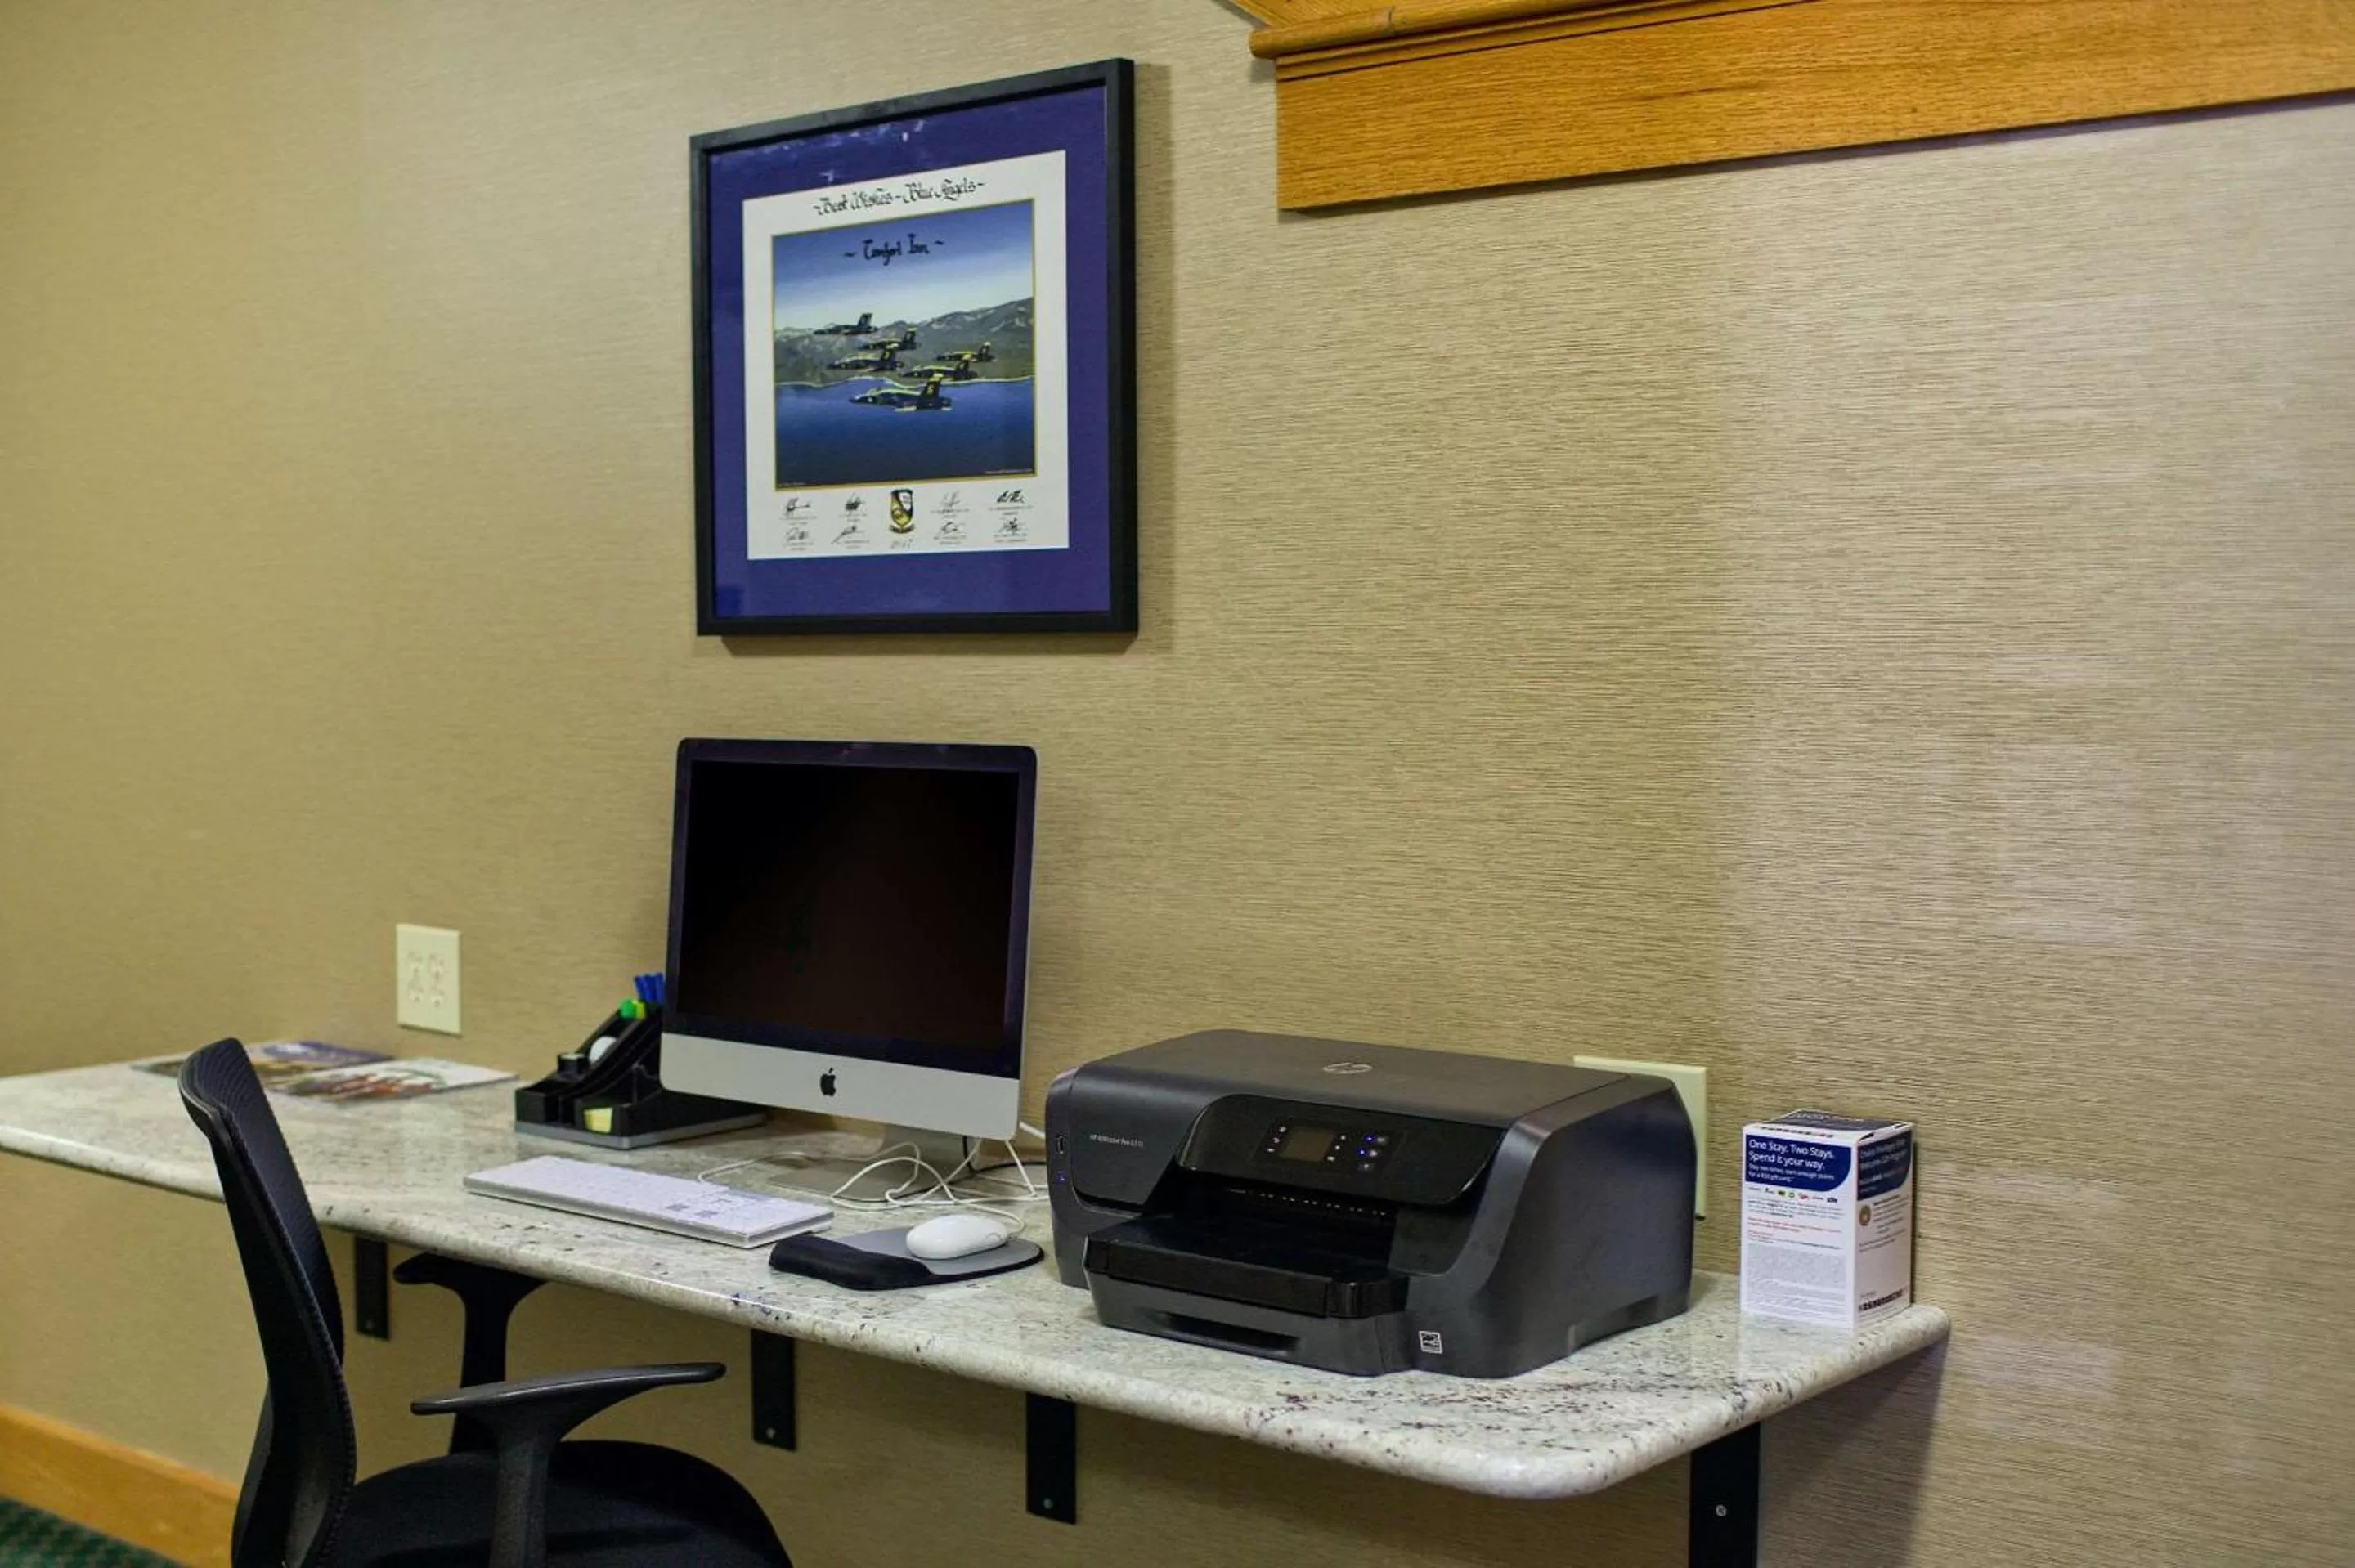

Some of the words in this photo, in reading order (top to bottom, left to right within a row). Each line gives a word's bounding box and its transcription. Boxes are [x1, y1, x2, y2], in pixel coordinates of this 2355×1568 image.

[863, 239, 903, 266] Comfort
[907, 232, 930, 254] Inn
[1748, 1139, 1767, 1149] One
[1790, 1144, 1809, 1155] Two
[1748, 1150, 1775, 1163] Spend
[1777, 1155, 1783, 1164] it
[1783, 1158, 1805, 1167] your
